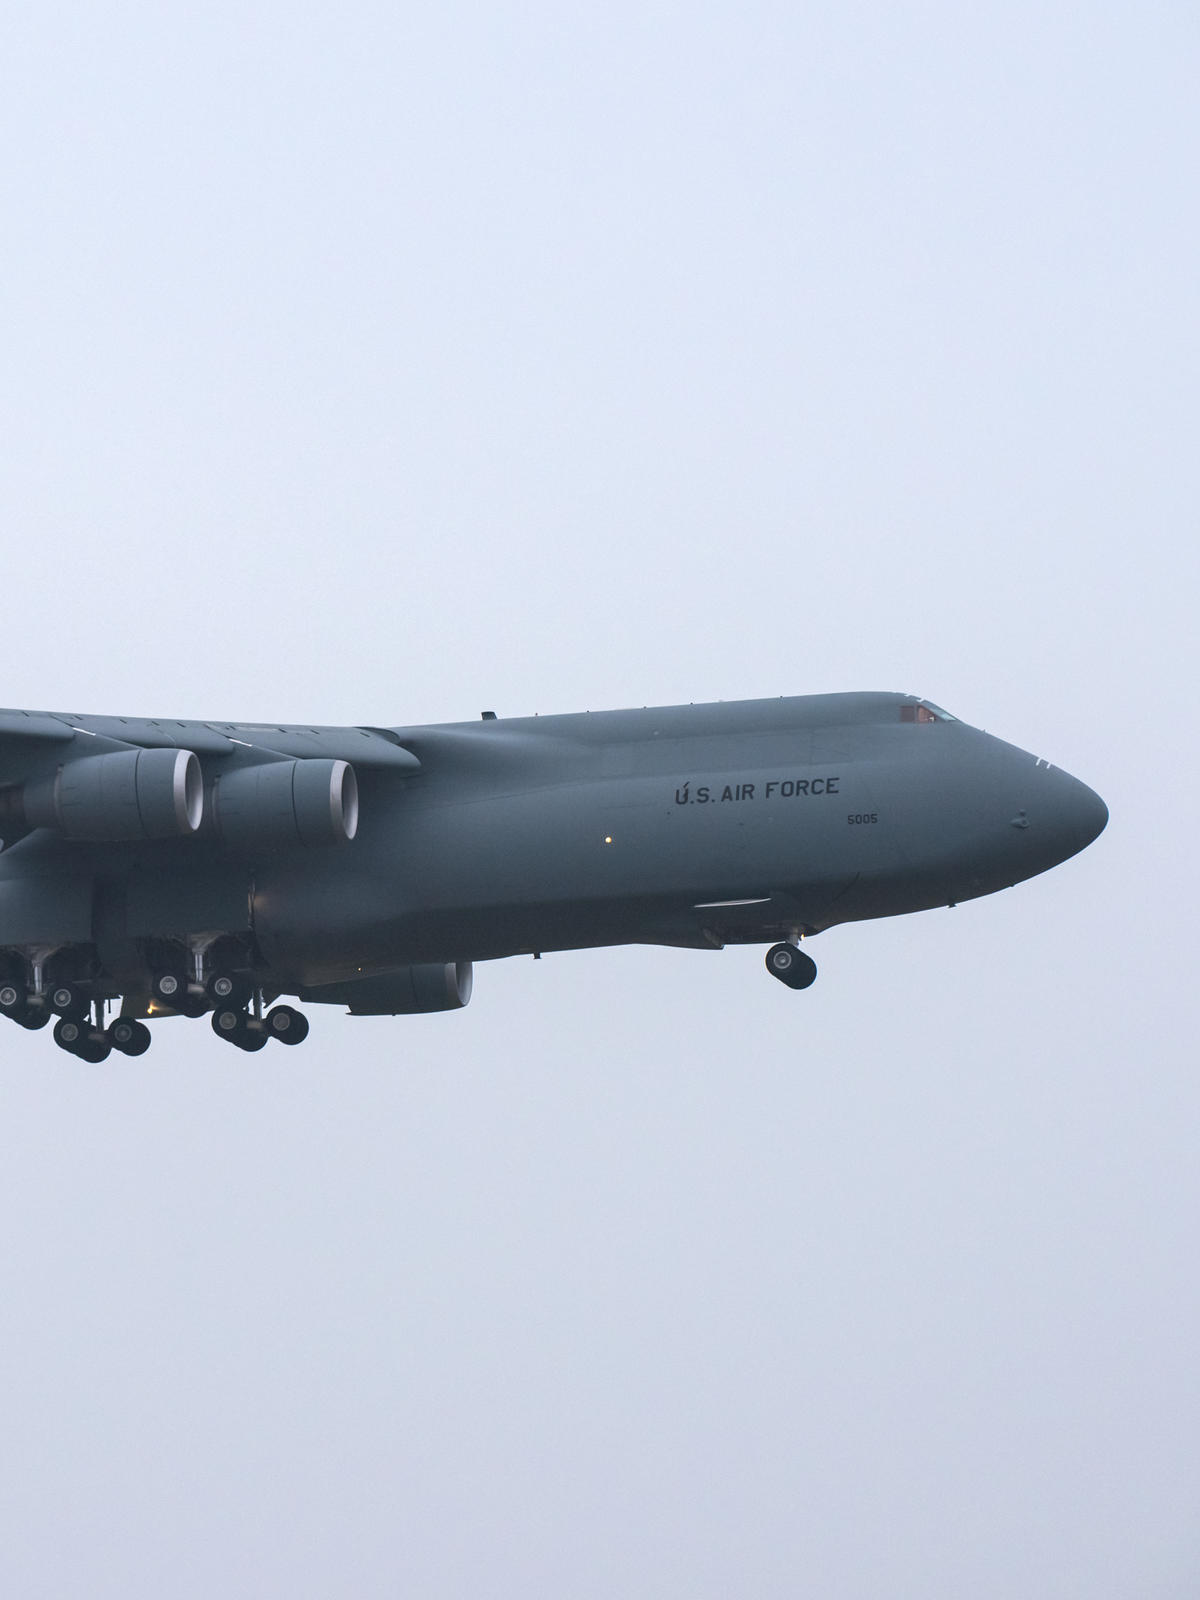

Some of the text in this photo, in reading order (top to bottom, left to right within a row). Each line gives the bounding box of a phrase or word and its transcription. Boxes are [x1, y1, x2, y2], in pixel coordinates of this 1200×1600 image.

[675, 777, 840, 805] U.S. AIR FORCE
[847, 813, 878, 825] 5005
